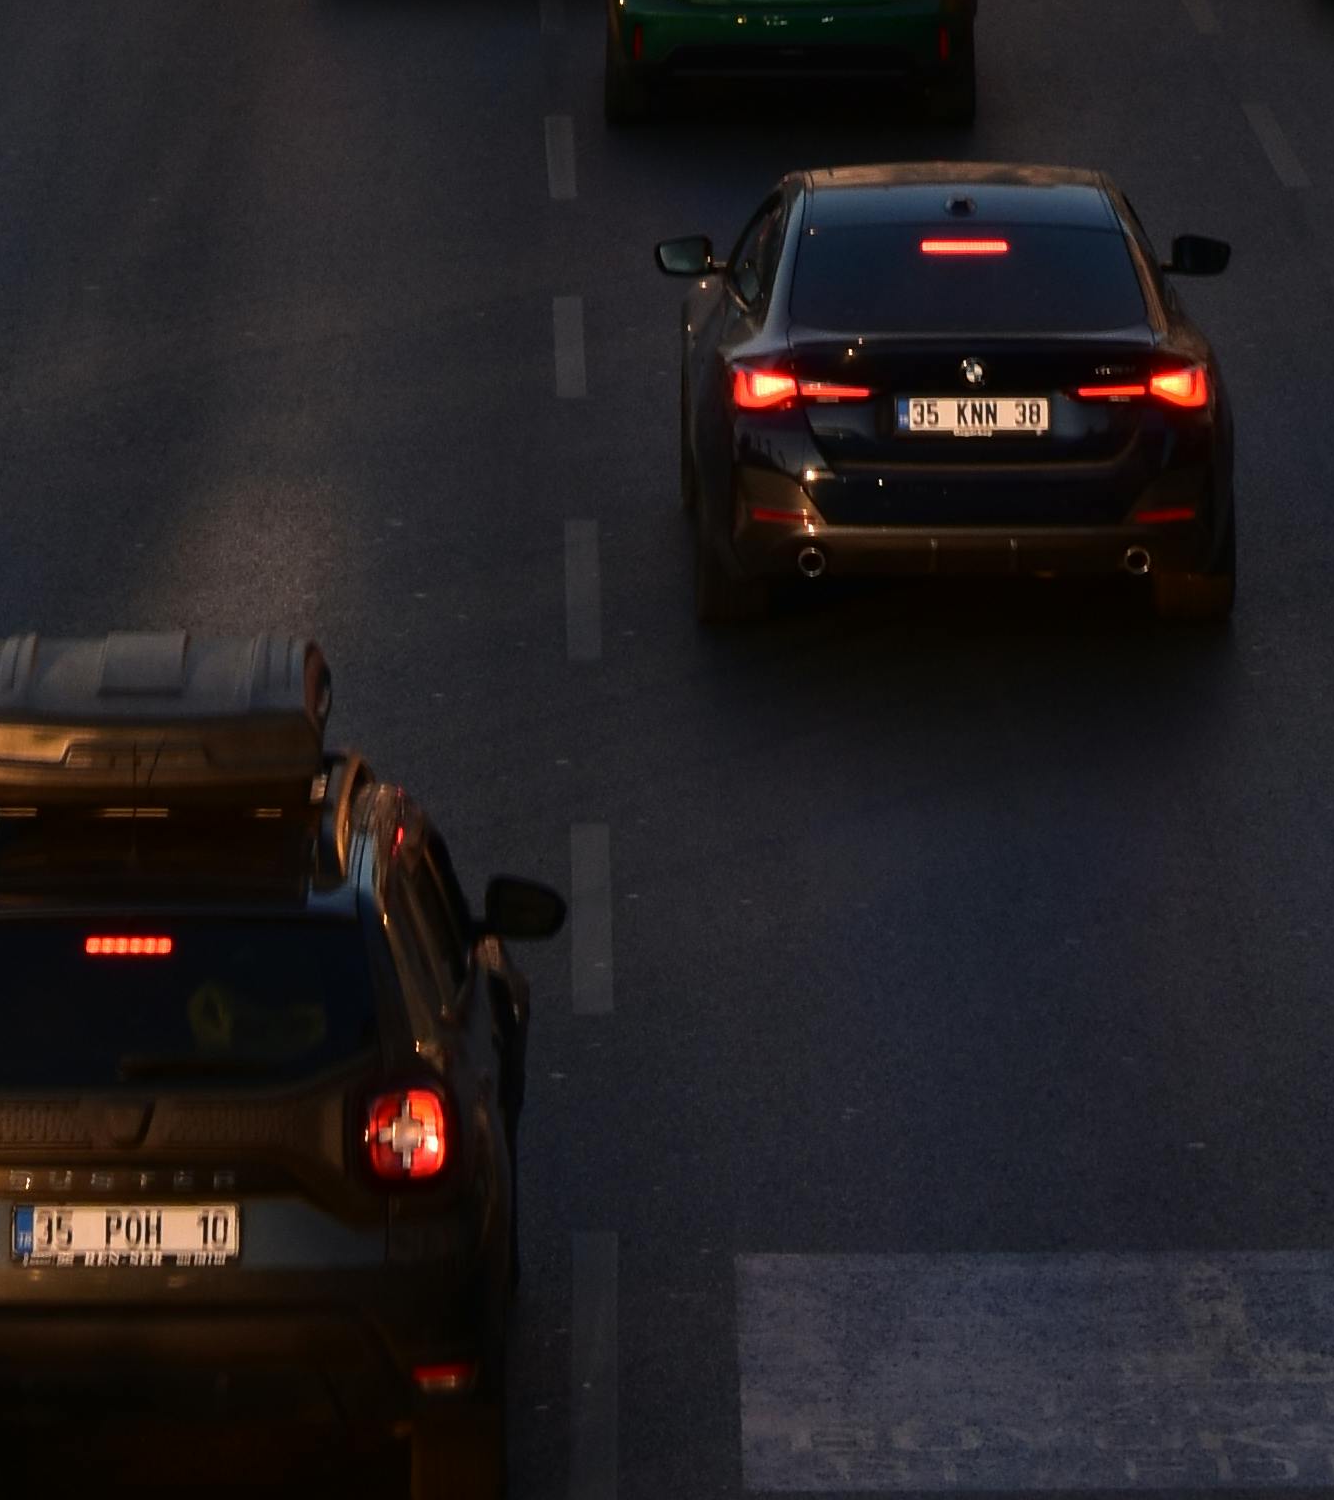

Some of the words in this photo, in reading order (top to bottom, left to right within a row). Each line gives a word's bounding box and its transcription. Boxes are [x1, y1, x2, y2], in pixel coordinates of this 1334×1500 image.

[912, 402, 939, 426] 35
[956, 402, 998, 426] KNN
[1015, 402, 1042, 426] 38
[36, 1209, 74, 1249] 35
[197, 1209, 229, 1247] 10
